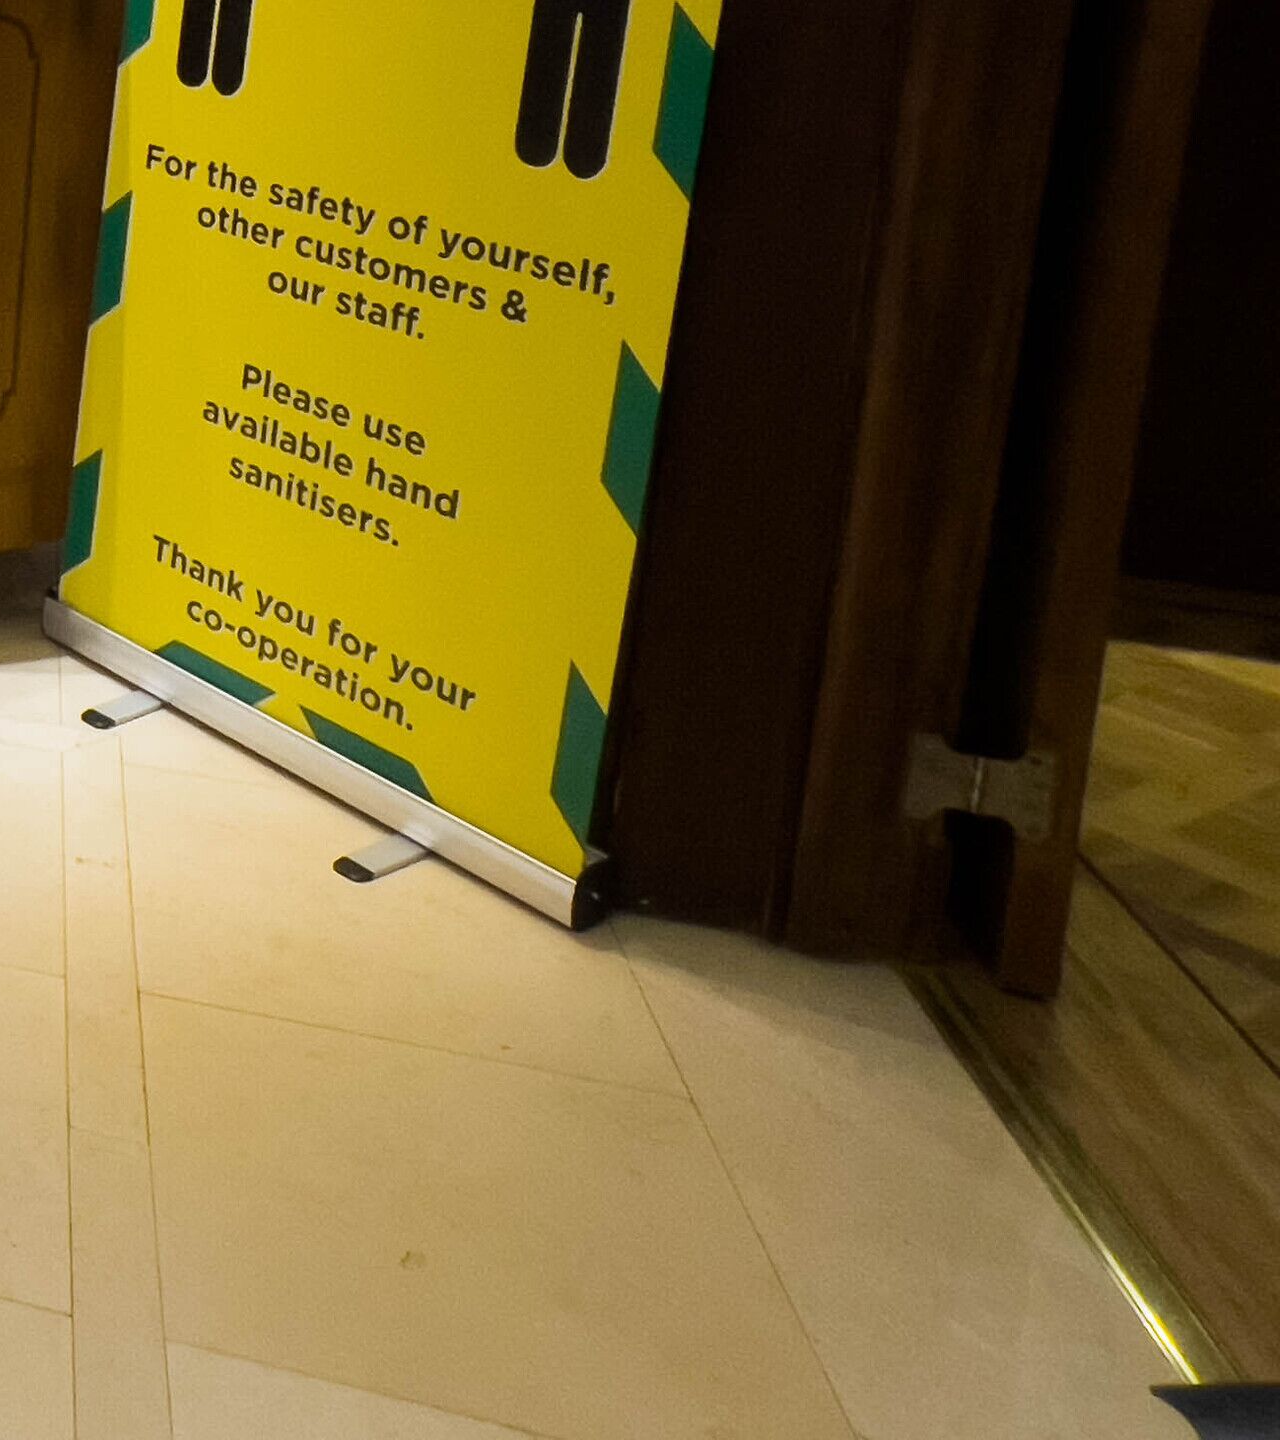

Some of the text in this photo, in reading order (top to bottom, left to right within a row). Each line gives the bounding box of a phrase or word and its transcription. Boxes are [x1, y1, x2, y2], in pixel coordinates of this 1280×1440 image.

[145, 144, 616, 306] For the safety of yourself,
[197, 204, 528, 323] other customers &
[267, 269, 425, 340] our staff.
[202, 397, 459, 520] available hand
[241, 364, 426, 456] Please use
[229, 455, 399, 547] sanitisers.
[152, 534, 476, 712] Thank you for your
[186, 598, 414, 731] co-operation.
